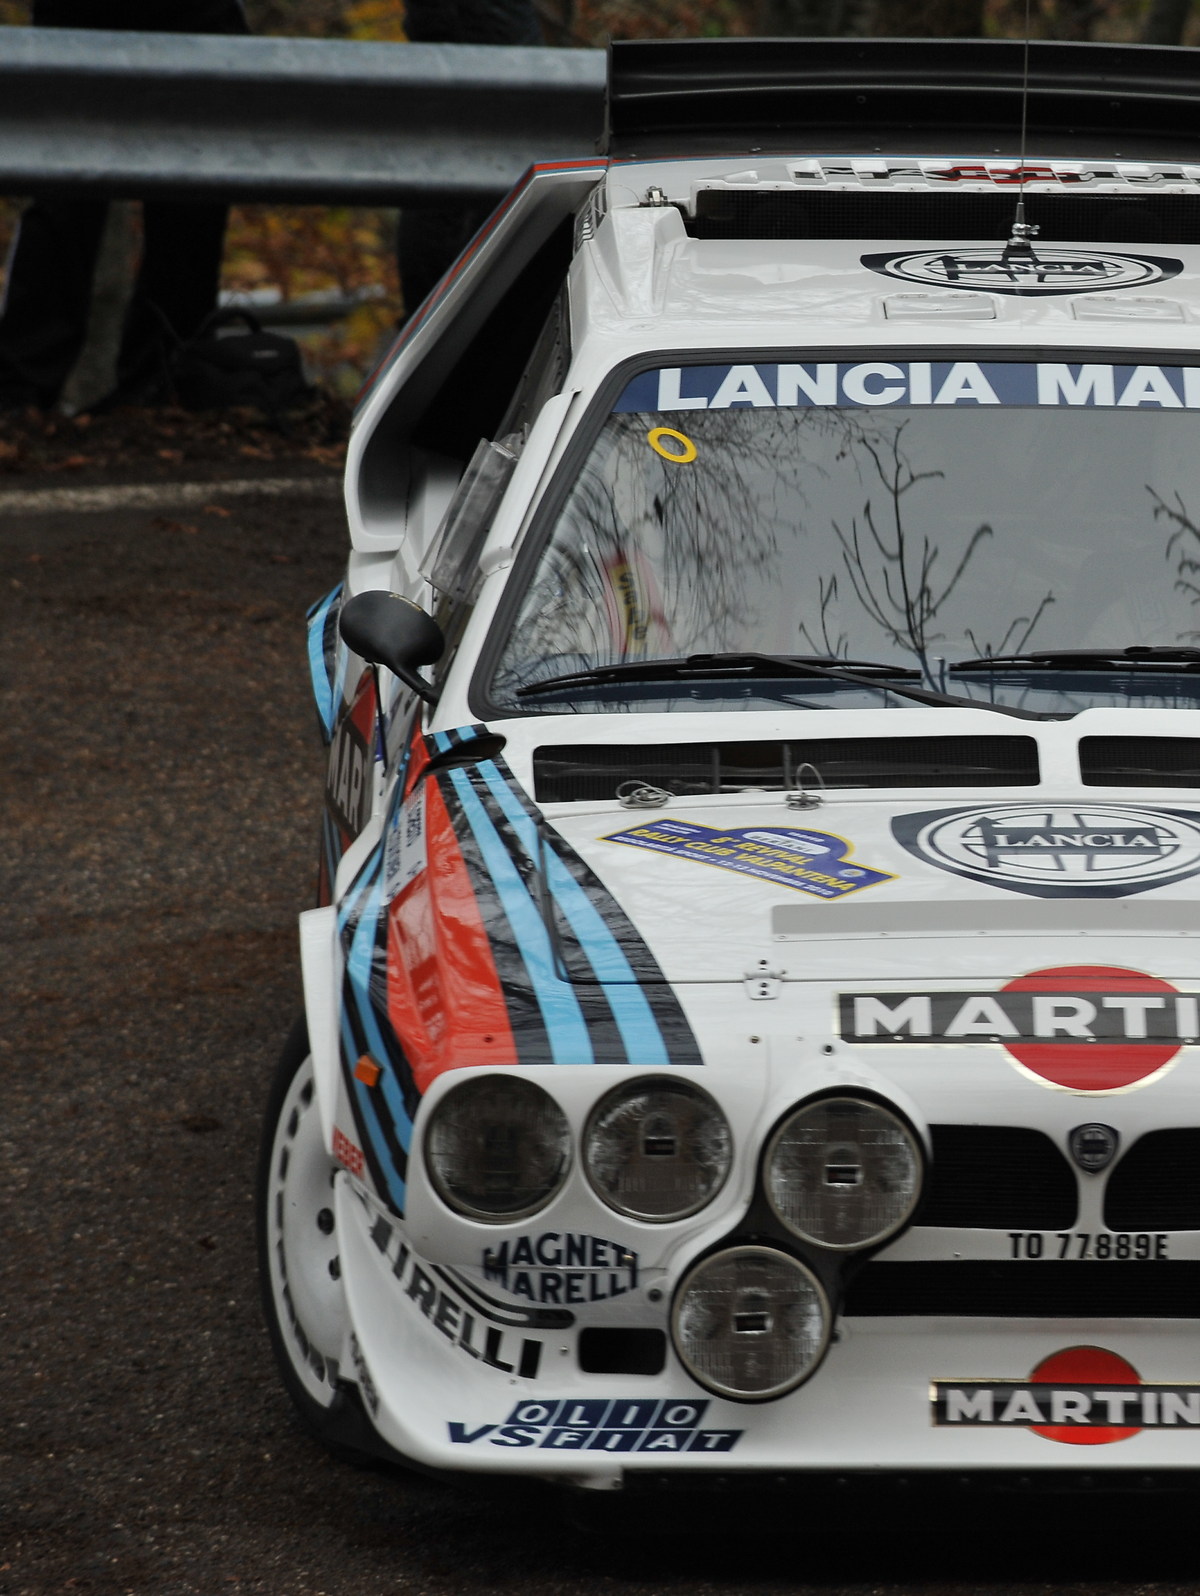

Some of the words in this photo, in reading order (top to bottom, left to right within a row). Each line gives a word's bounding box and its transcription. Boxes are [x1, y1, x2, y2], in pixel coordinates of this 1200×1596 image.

[957, 263, 1101, 272] LANCIA
[657, 361, 1001, 411] LANCIA
[736, 841, 815, 865] REVIVAL
[994, 834, 1160, 847] LANCIA
[629, 828, 690, 844] RALLY
[685, 840, 737, 857] CLUB
[731, 852, 858, 892] VALPANTENA
[1008, 1232, 1042, 1259] TO
[1056, 1233, 1168, 1260] 77889E
[484, 1266, 638, 1304] MARELLI
[508, 1401, 704, 1426] OLIO
